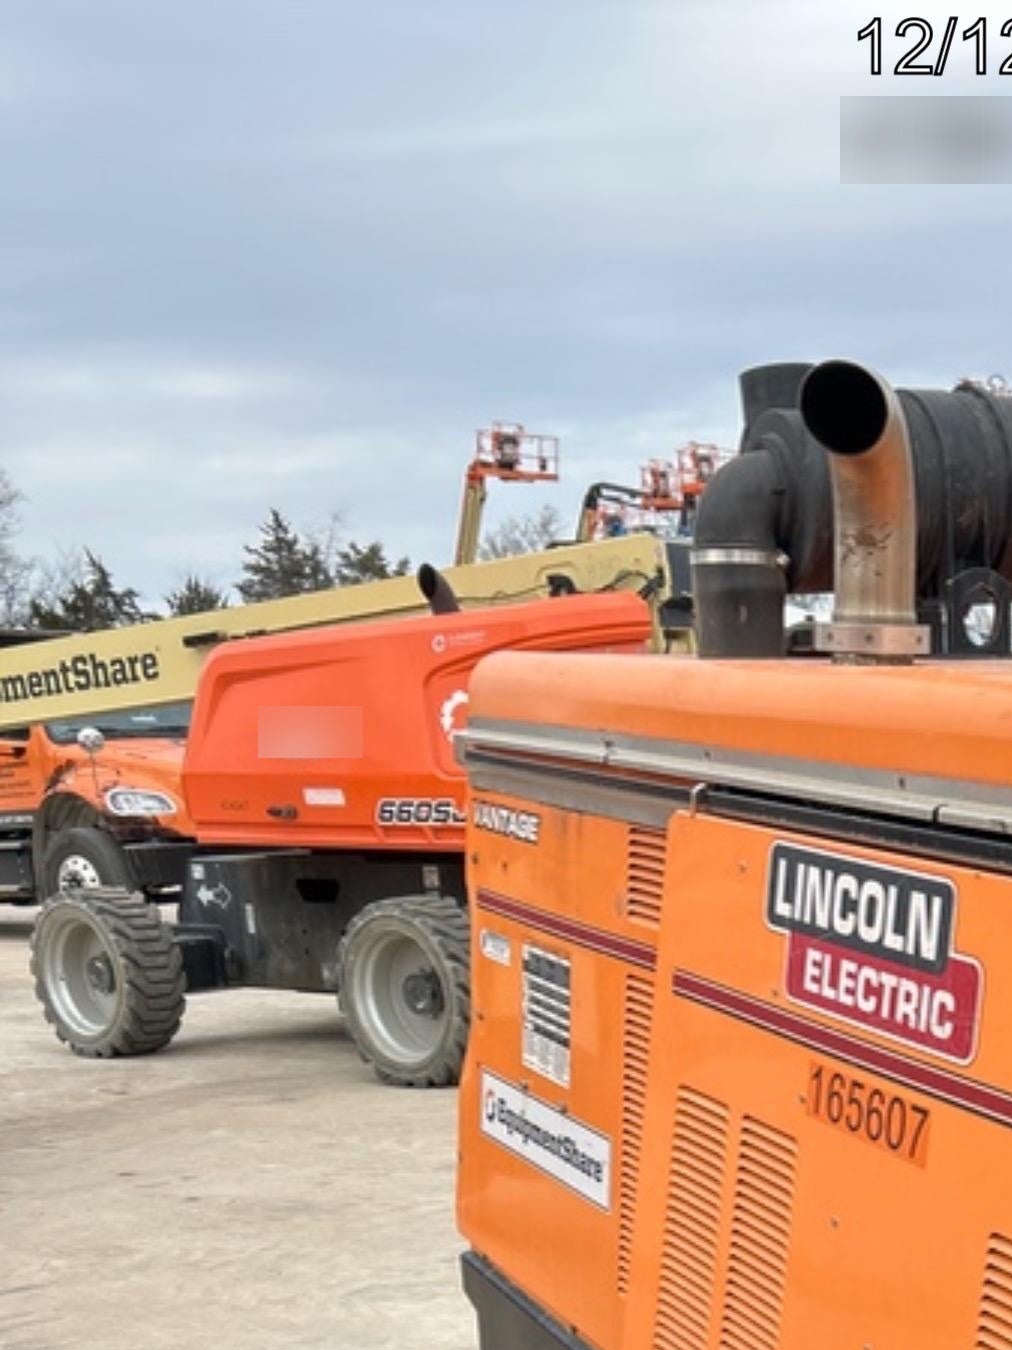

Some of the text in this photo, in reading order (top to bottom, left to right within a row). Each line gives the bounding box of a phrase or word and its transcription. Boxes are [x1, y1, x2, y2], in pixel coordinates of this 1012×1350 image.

[772, 856, 943, 962] LINCOLN
[802, 946, 956, 1040] ELECTRIC
[807, 1064, 931, 1160] 165607
